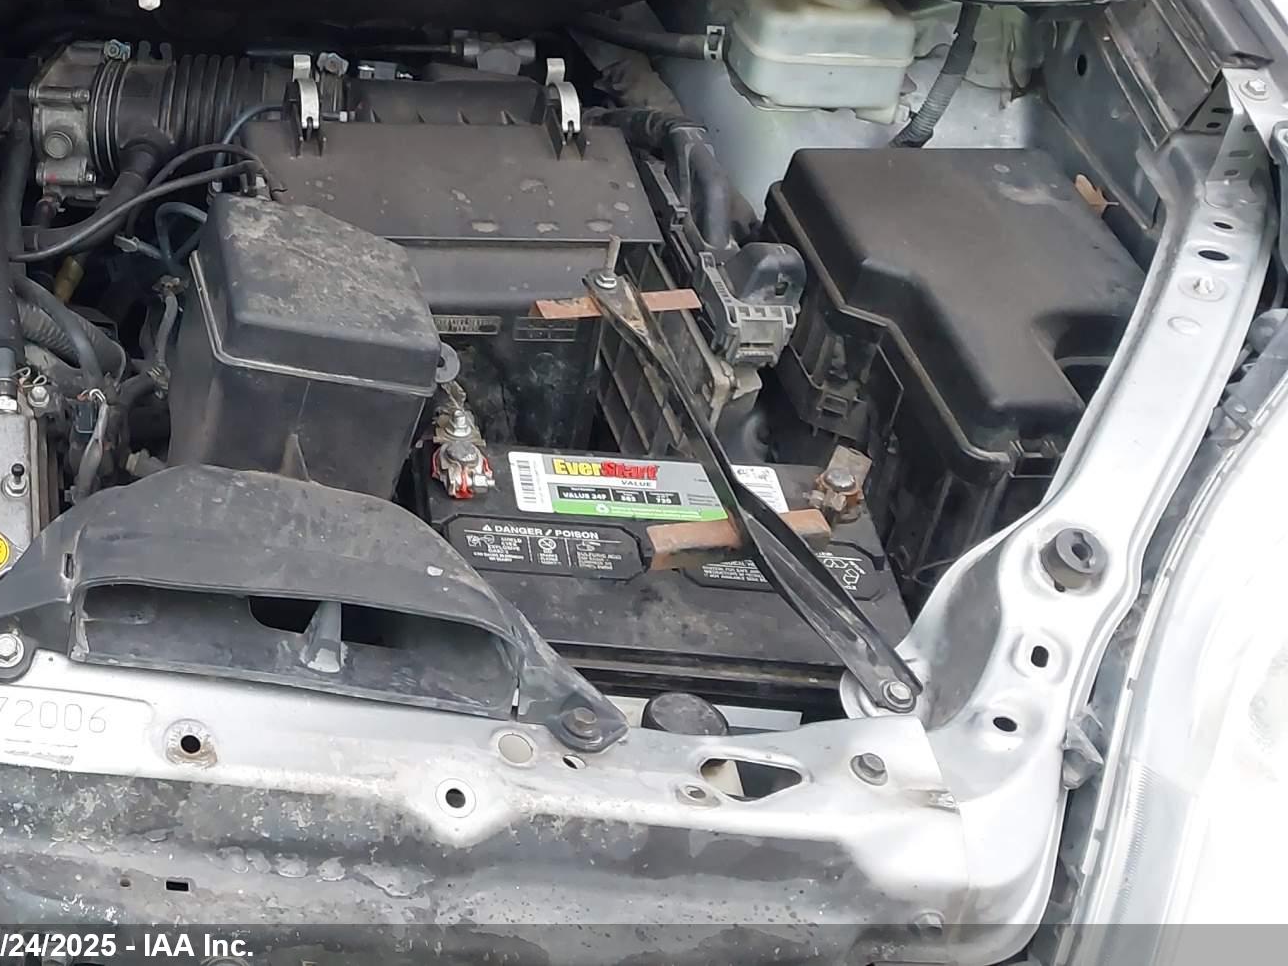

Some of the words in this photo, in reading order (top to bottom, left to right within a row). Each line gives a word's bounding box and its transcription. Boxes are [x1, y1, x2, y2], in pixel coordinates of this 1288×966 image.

[552, 458, 659, 480] EverStart
[621, 479, 652, 487] VALUE
[494, 525, 543, 536] DANGER
[555, 529, 600, 540] POISON
